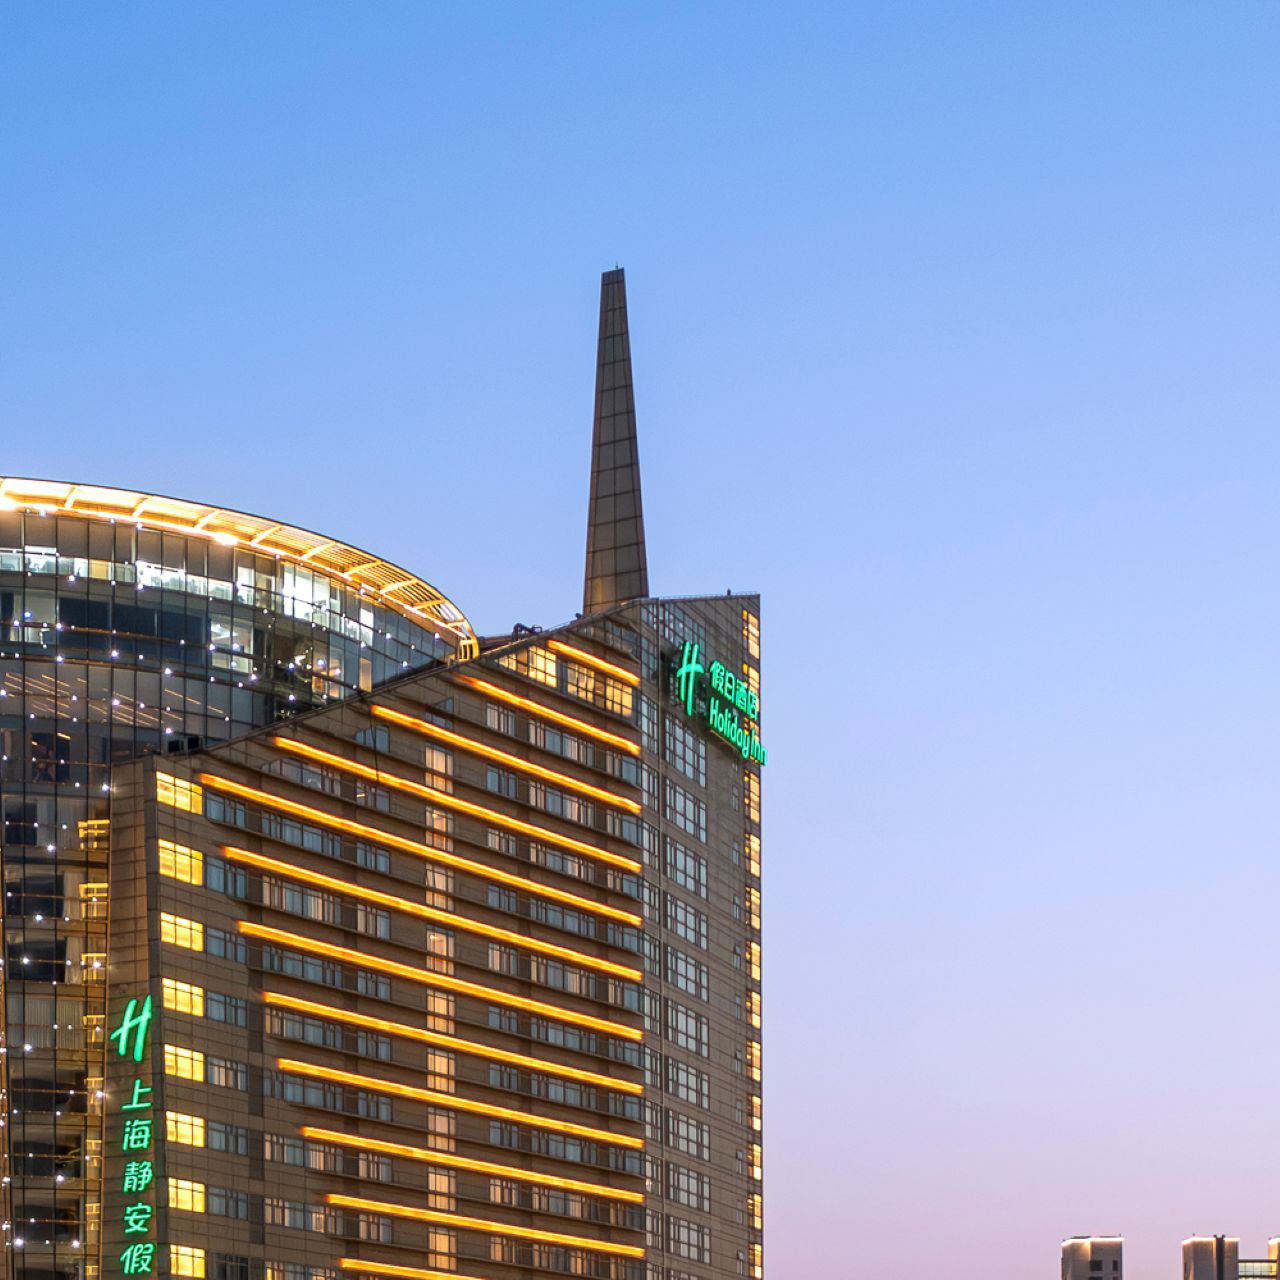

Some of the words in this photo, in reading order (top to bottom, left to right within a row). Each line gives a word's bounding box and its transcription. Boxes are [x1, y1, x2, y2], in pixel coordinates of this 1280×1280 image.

[709, 660, 759, 721] 假日酒店
[709, 696, 750, 760] Holiday
[751, 728, 768, 766] Inn
